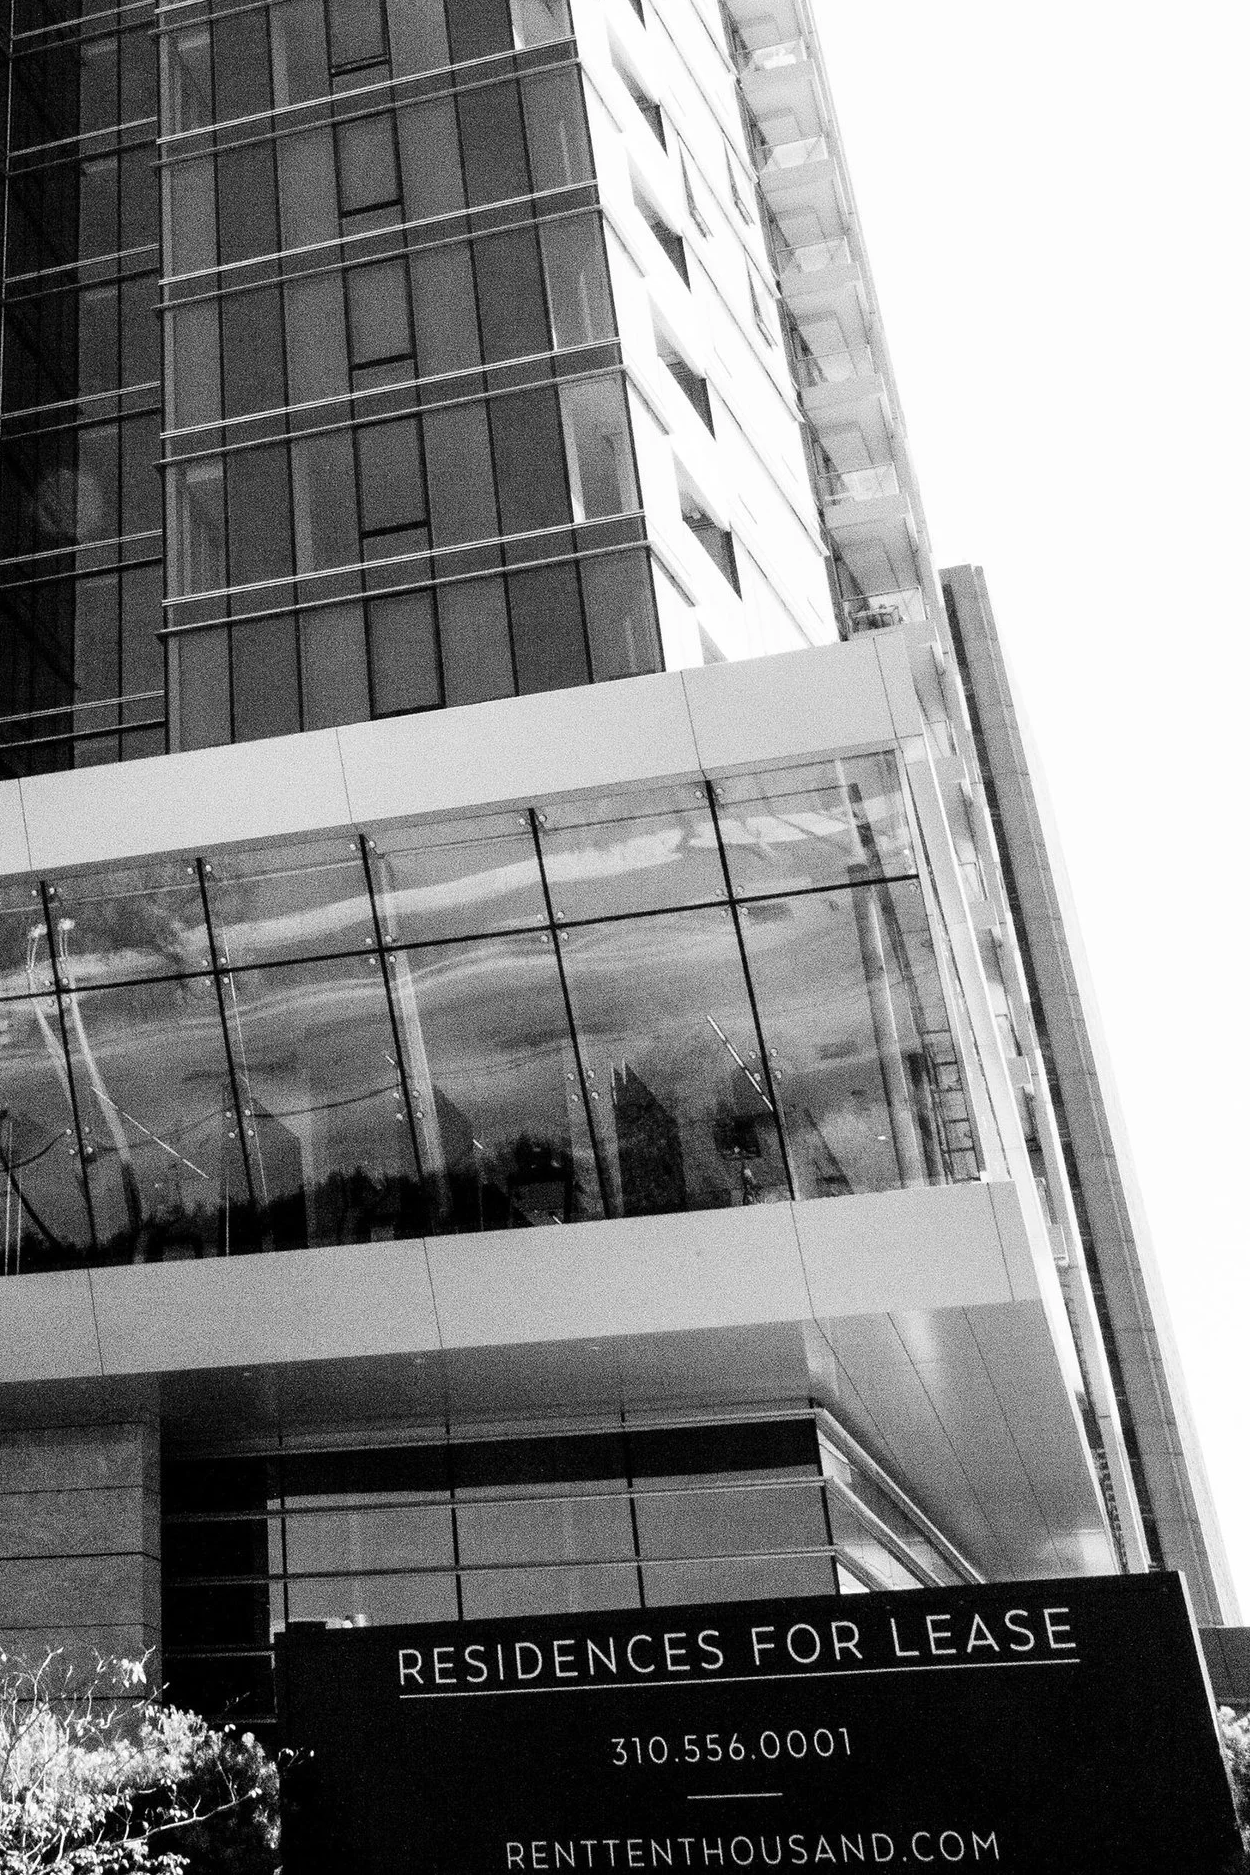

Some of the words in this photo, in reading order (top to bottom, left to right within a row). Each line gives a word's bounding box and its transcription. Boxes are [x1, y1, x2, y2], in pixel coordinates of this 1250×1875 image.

[398, 1629, 724, 1685] RESIDENCES
[751, 1621, 863, 1666] FOR
[890, 1607, 1077, 1657] LEASE
[611, 1727, 851, 1765] 310.556.0001
[506, 1830, 1000, 1869] RENTTENTHOUSAND.COM
